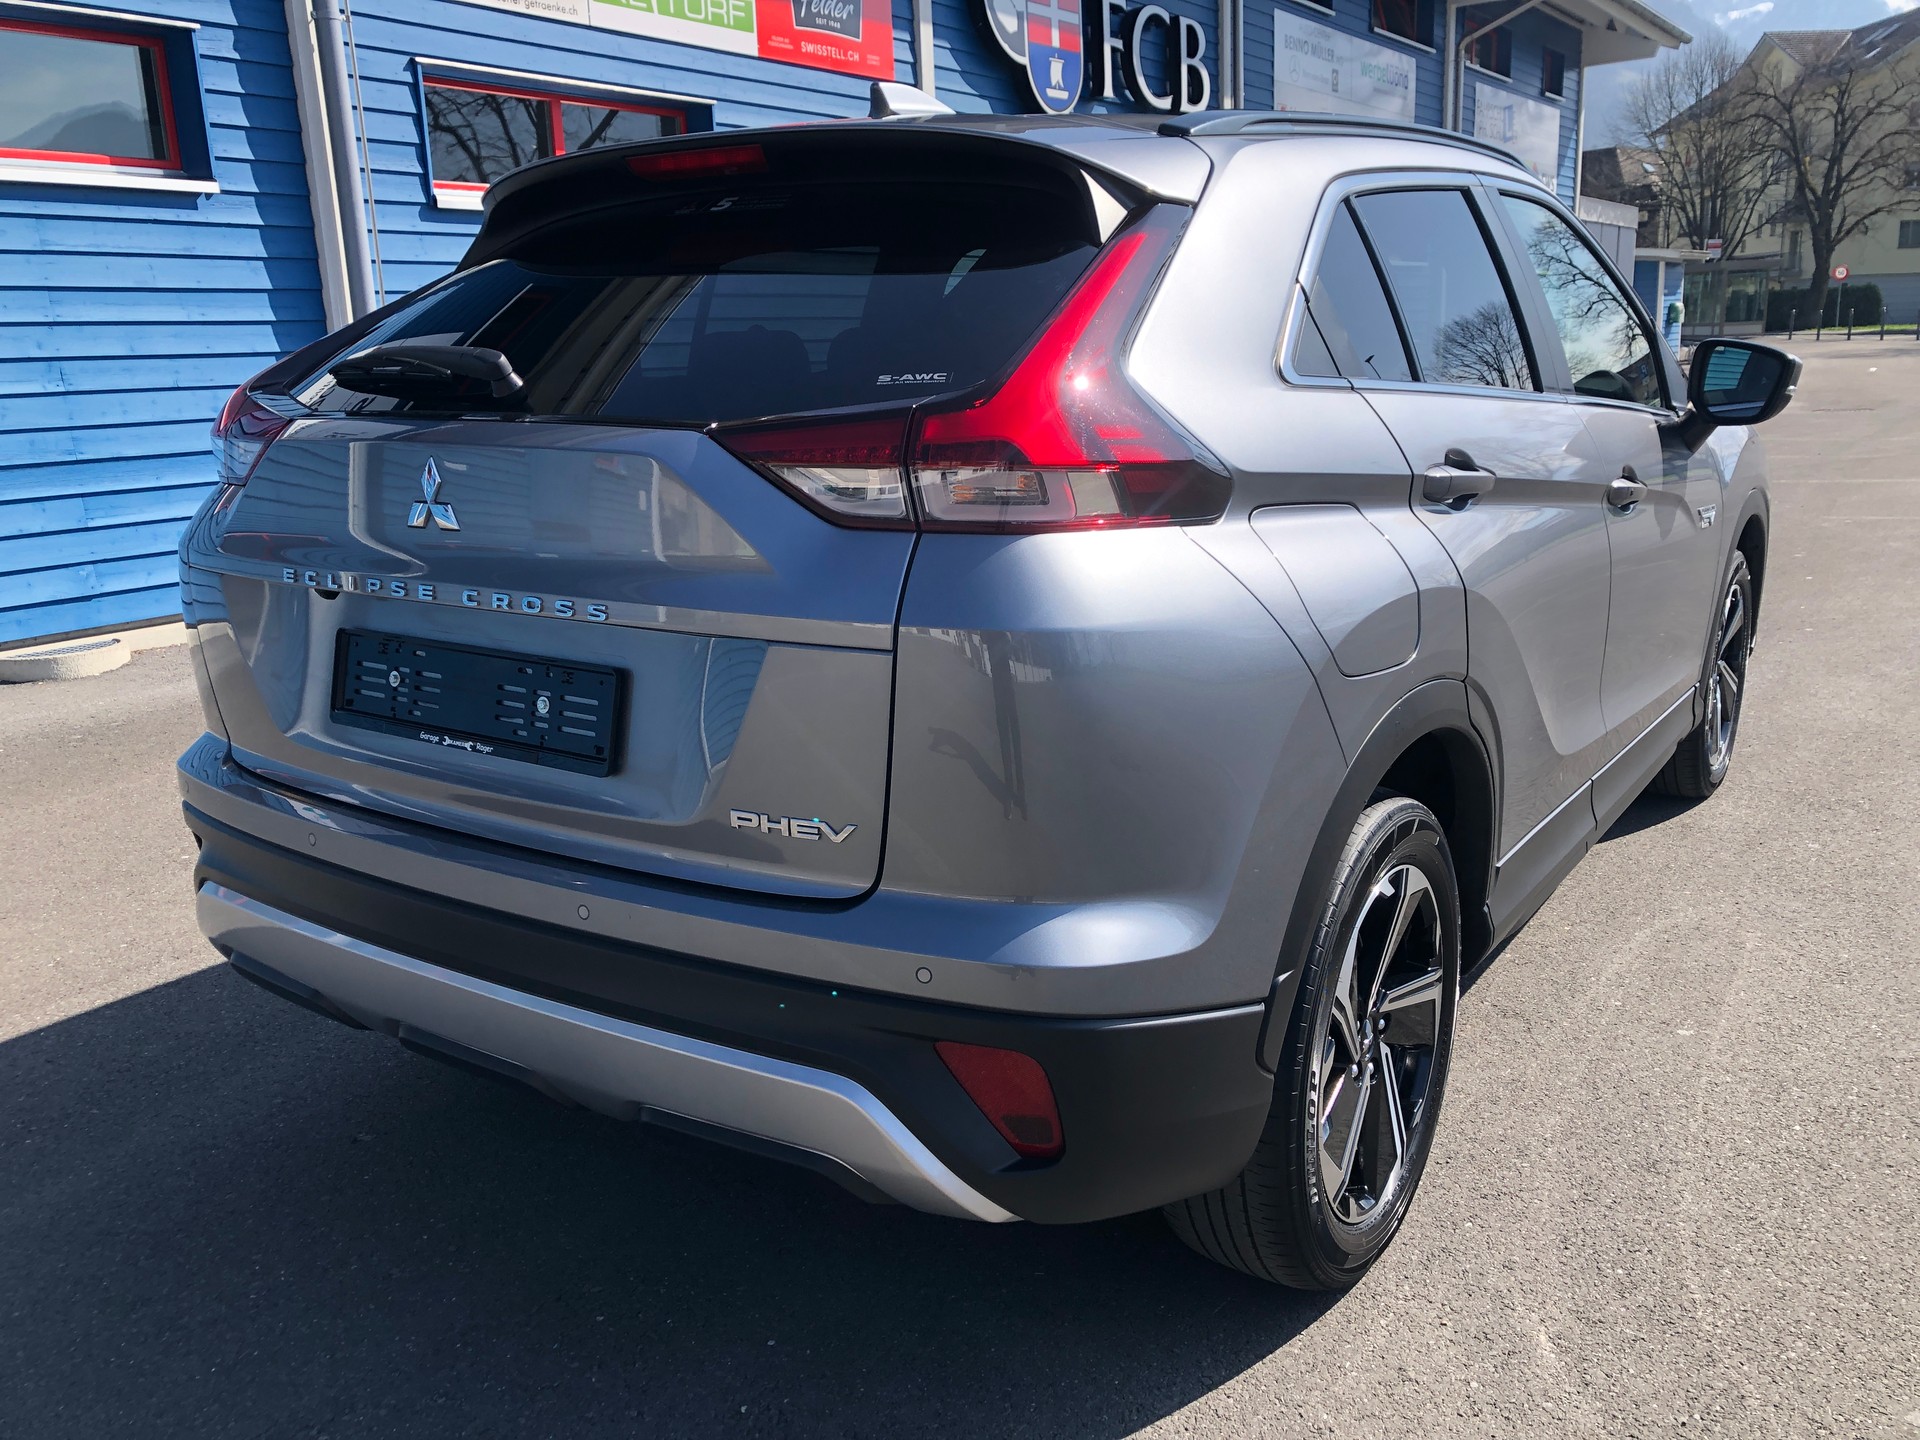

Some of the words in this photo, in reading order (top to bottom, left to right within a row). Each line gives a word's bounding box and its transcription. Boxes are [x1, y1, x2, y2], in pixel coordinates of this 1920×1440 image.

[801, 41, 860, 62] SWISSTELL.CH
[1102, 0, 1211, 112] FCB
[878, 373, 947, 381] S-AWC
[283, 567, 437, 601] ECLIPSE
[462, 589, 609, 622] CROSS
[420, 731, 439, 743] Garage
[476, 742, 493, 753] Roger
[730, 808, 858, 843] PHEV
[1307, 1070, 1319, 1206] DUNLOP
